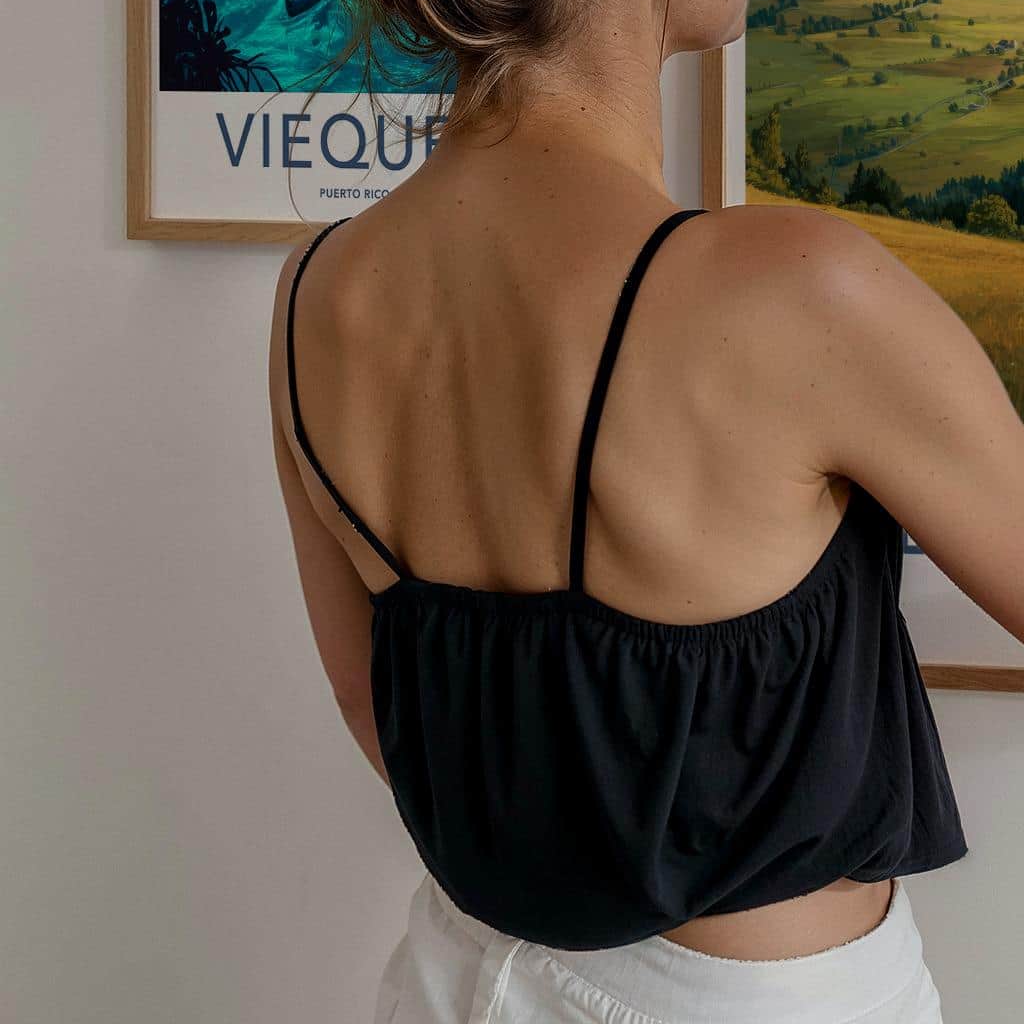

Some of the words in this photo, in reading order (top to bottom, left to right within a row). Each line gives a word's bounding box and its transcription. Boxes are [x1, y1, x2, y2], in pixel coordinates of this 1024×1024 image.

[215, 112, 450, 171] VIEQUE
[319, 187, 361, 199] PUERTO
[364, 188, 390, 199] RICO
